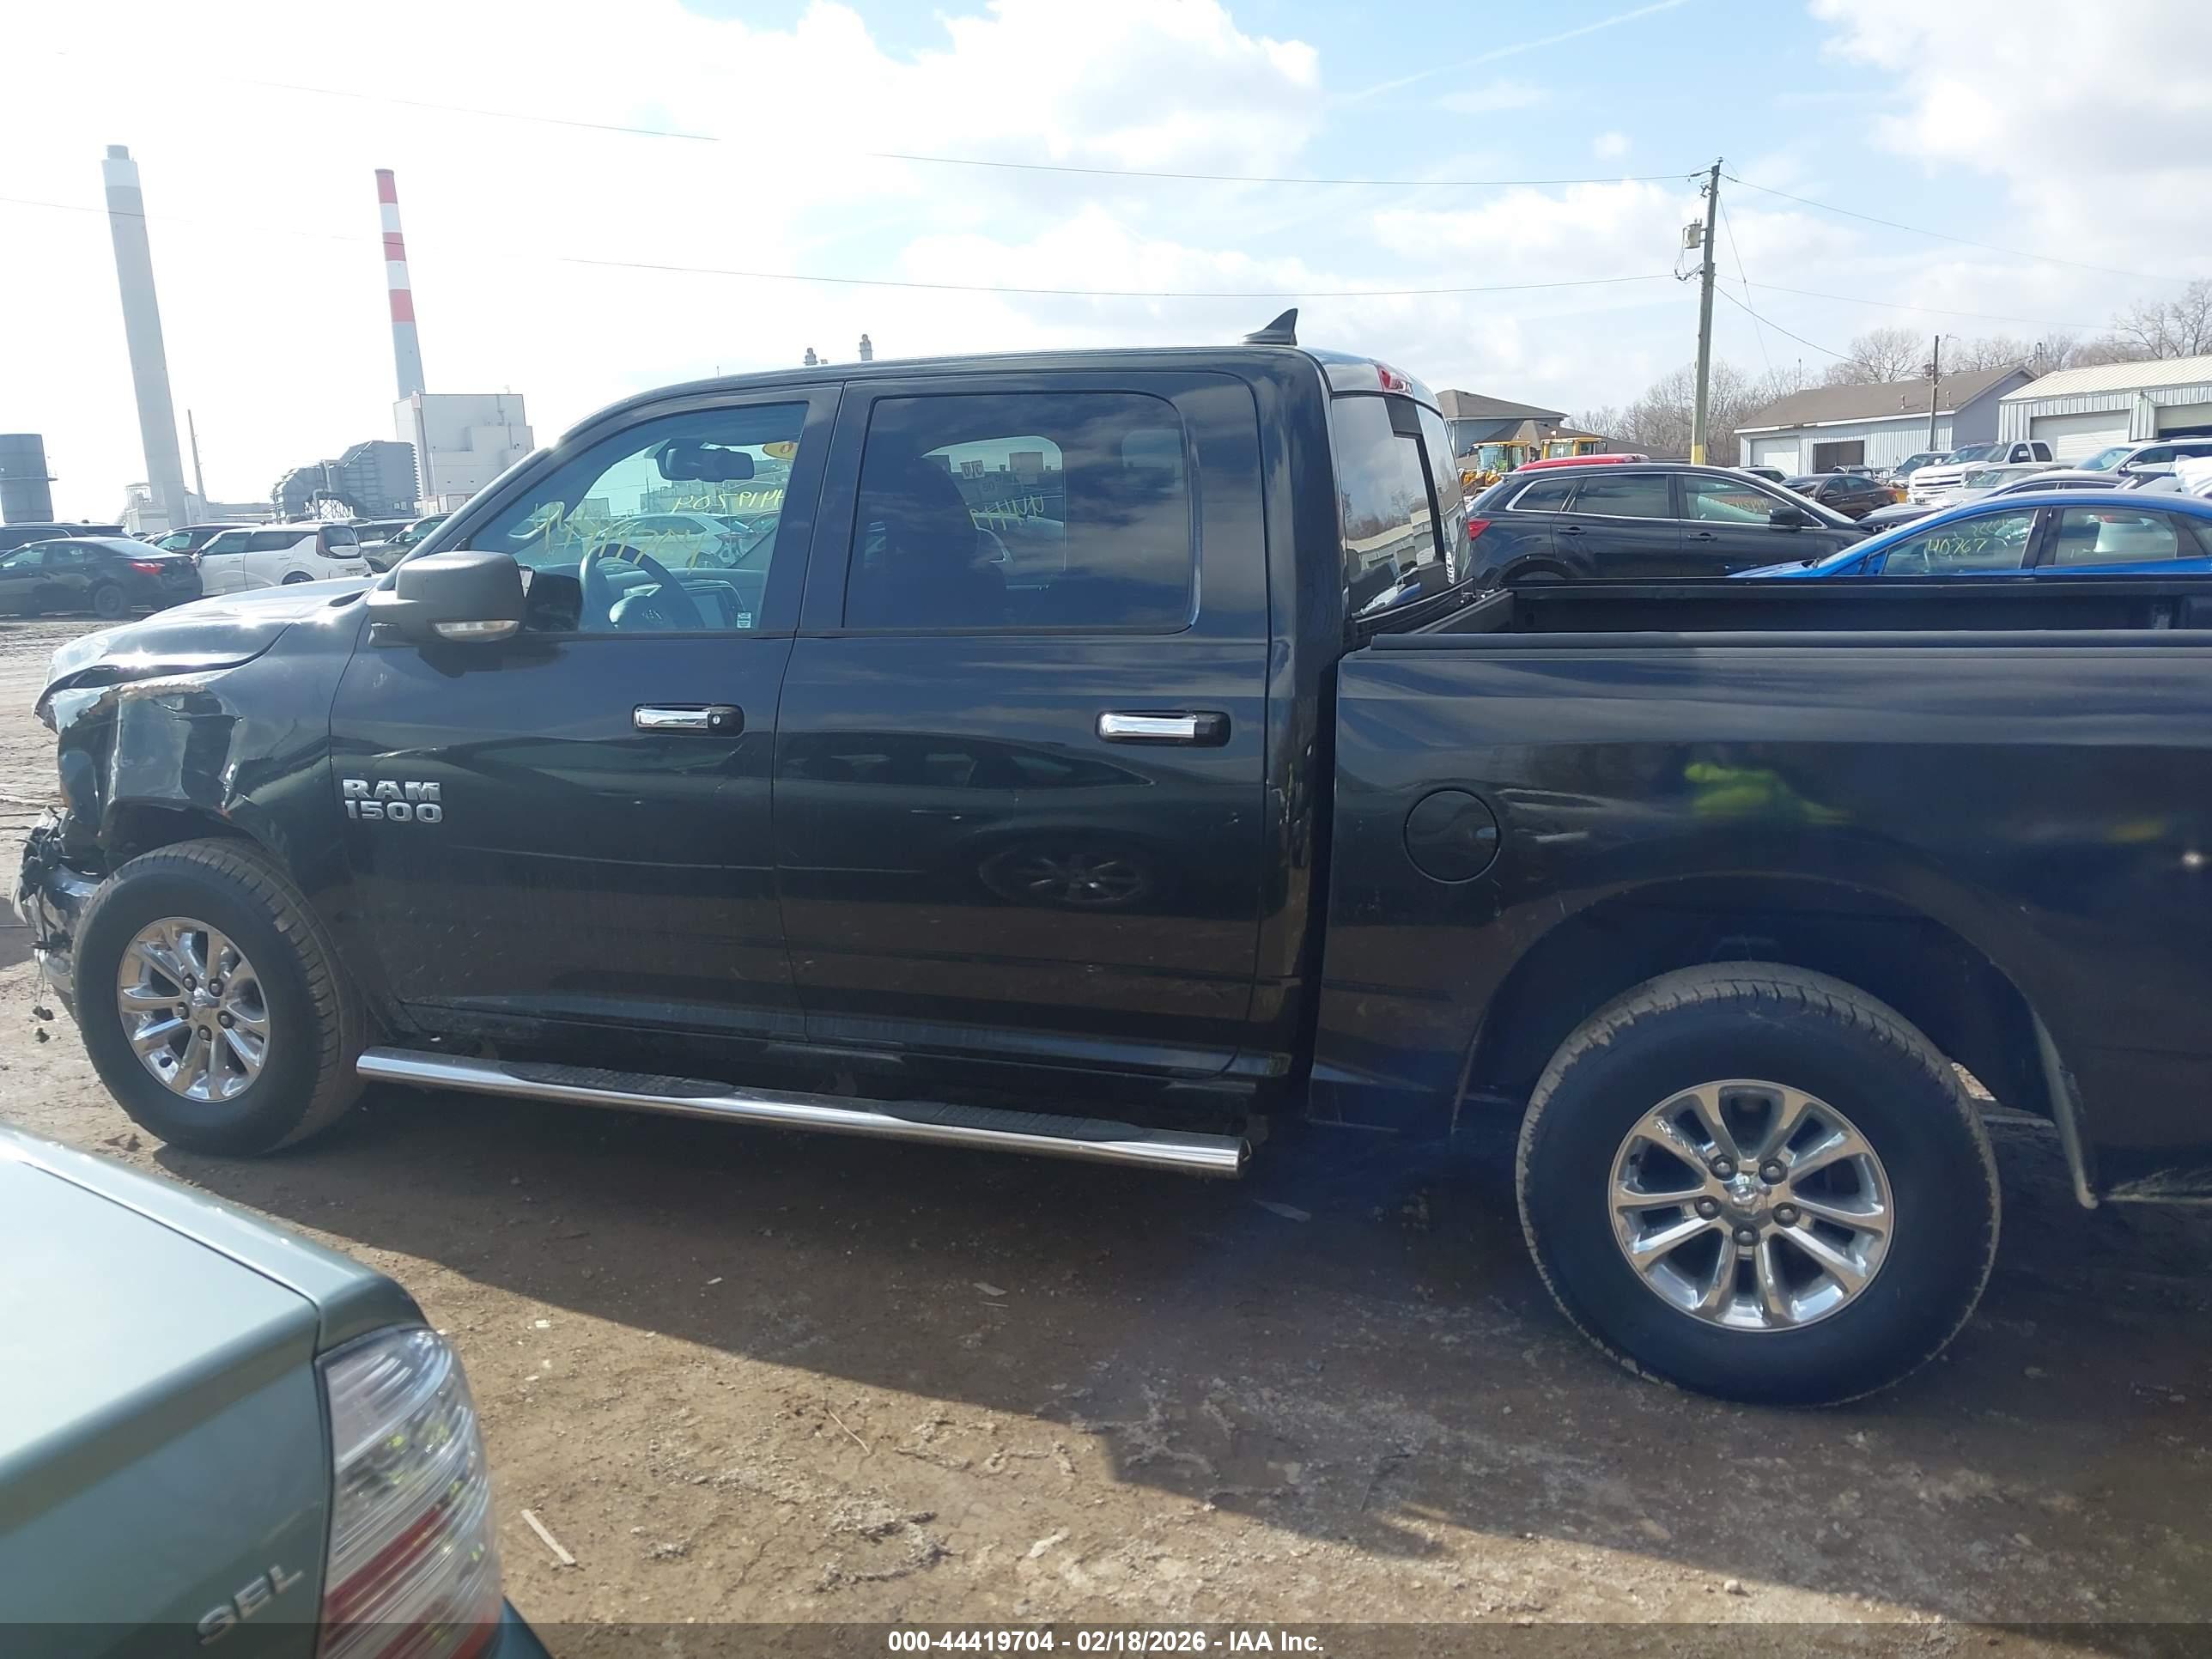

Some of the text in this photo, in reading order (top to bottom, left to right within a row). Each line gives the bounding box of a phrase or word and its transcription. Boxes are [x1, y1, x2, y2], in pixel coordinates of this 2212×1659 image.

[343, 779, 441, 801] RAM
[344, 800, 443, 823] 1500
[197, 1565, 303, 1646] SEL
